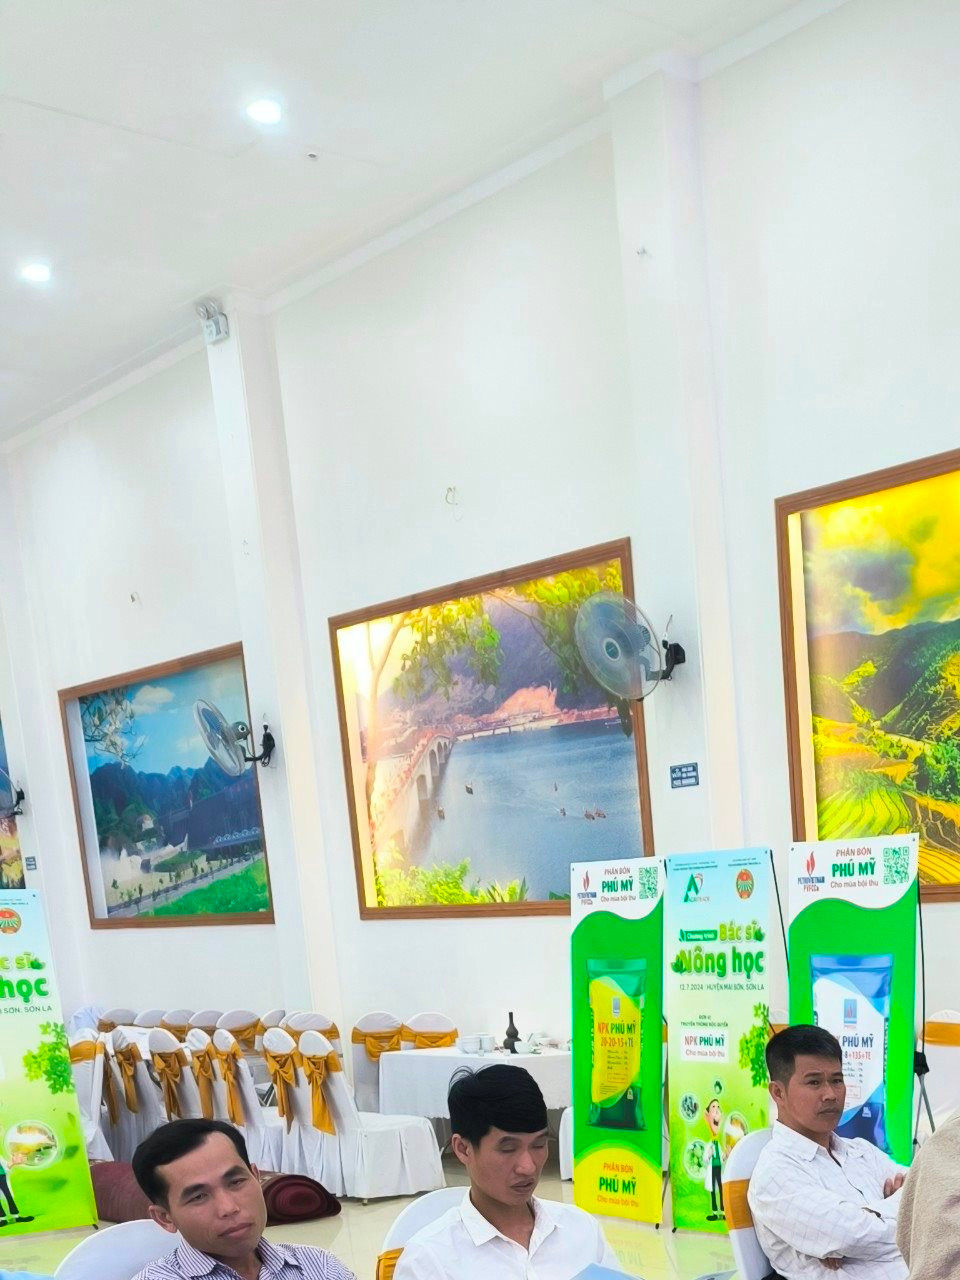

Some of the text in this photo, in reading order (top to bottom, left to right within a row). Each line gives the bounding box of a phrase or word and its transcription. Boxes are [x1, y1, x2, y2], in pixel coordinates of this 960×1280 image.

[836, 848, 855, 857] PHÂN
[832, 857, 876, 877] PHÚ MỸ
[602, 875, 633, 893] PHÚ MỸ
[830, 881, 842, 889] Cho
[869, 879, 878, 887] thu
[720, 920, 741, 941] Bác
[676, 945, 764, 979] Nông học
[611, 1020, 625, 1034] PHÚ
[627, 1020, 636, 1034] MỸ
[684, 1034, 724, 1046] NPK PHÚ MỸ
[842, 1033, 859, 1048] PHÚ
[861, 1033, 874, 1048] MỸ
[599, 1174, 636, 1195] PHÚ MỸ
